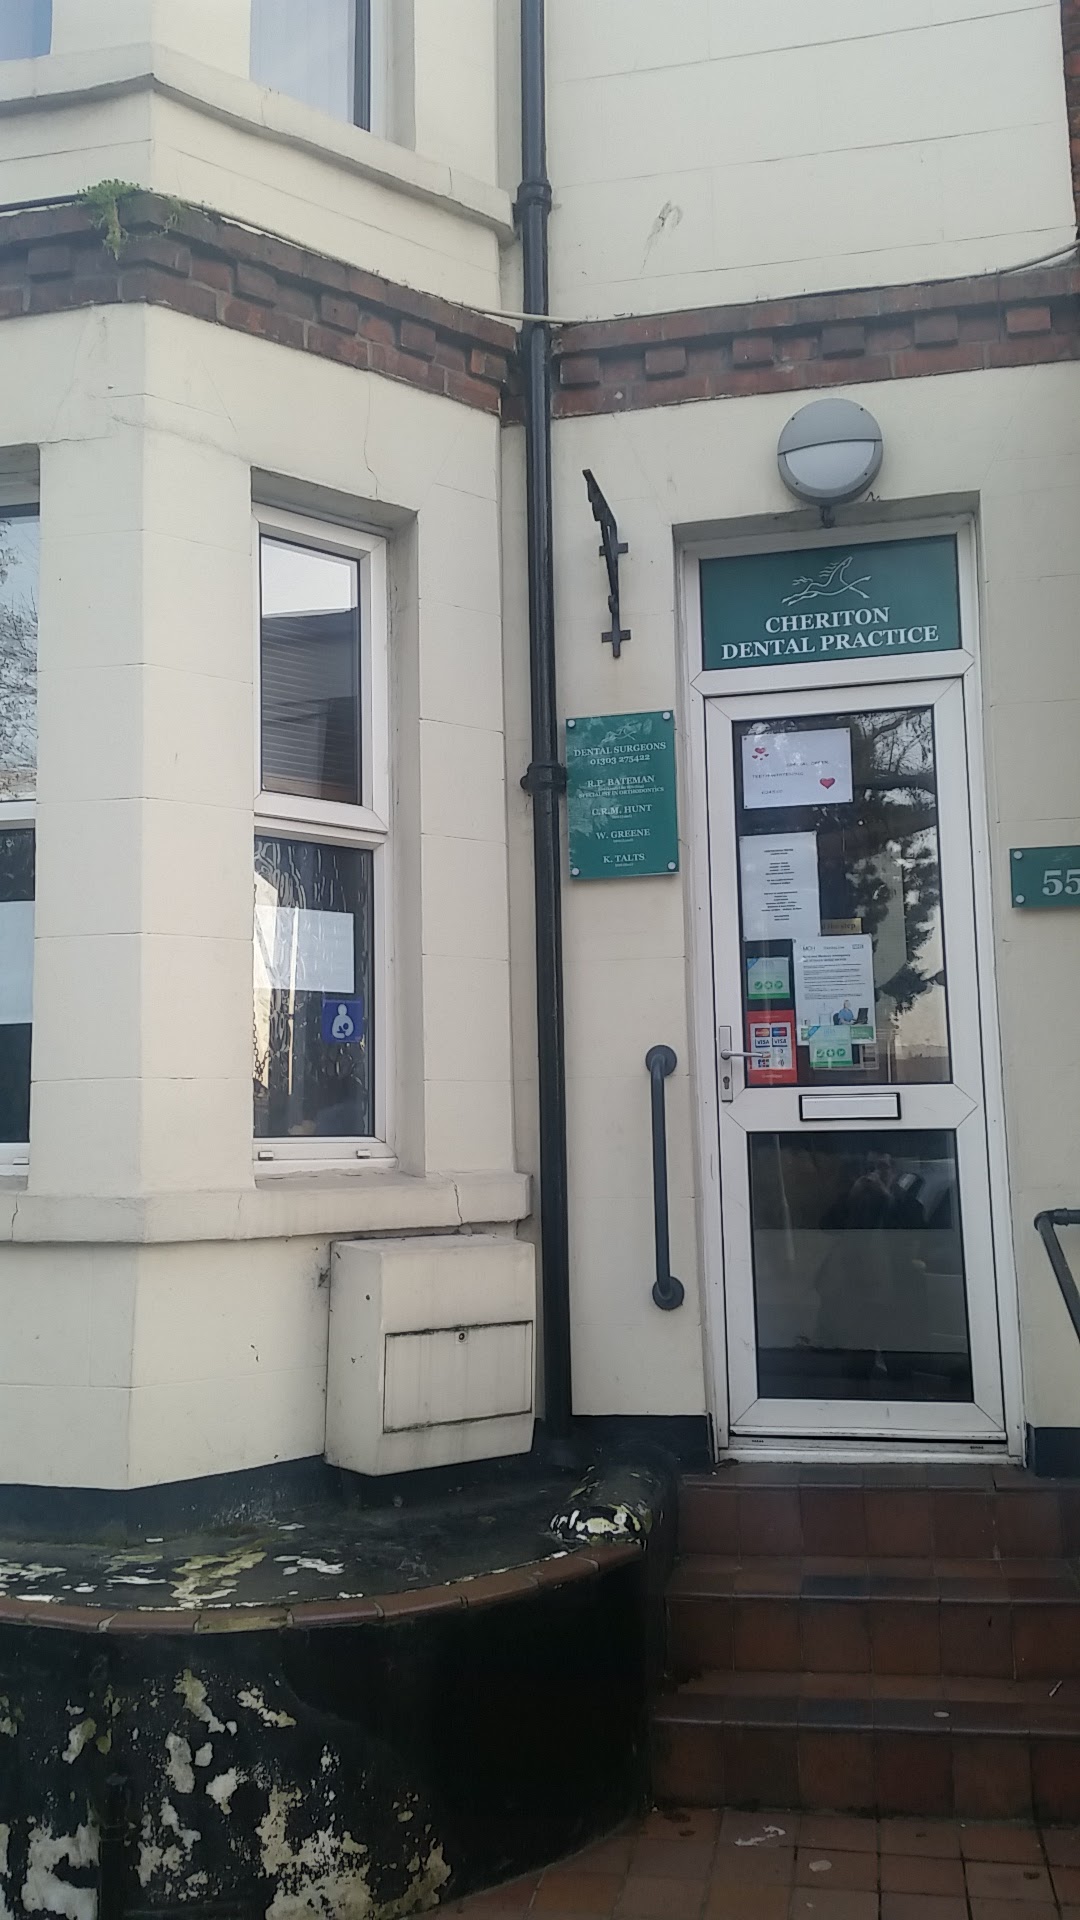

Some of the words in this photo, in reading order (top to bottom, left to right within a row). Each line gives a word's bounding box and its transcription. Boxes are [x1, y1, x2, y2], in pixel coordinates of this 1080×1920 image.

[765, 607, 890, 633] CHERITON
[721, 637, 816, 660] DENTAL
[820, 626, 939, 651] PRACTICE
[574, 746, 612, 757] DENTAL
[613, 742, 666, 754] SURGEONS
[590, 757, 617, 766] 01303
[618, 754, 651, 764] 275422
[587, 779, 606, 788] R.P.
[608, 775, 655, 786] BATEMAN
[619, 787, 665, 795] ORTHODONTICS
[591, 806, 622, 816] C.R.M.
[624, 804, 652, 813] HUNT
[596, 832, 609, 840] W.
[610, 828, 651, 838] GREENE
[603, 855, 613, 863] K.
[614, 853, 645, 862] TALTS
[1042, 869, 1080, 896] 55
